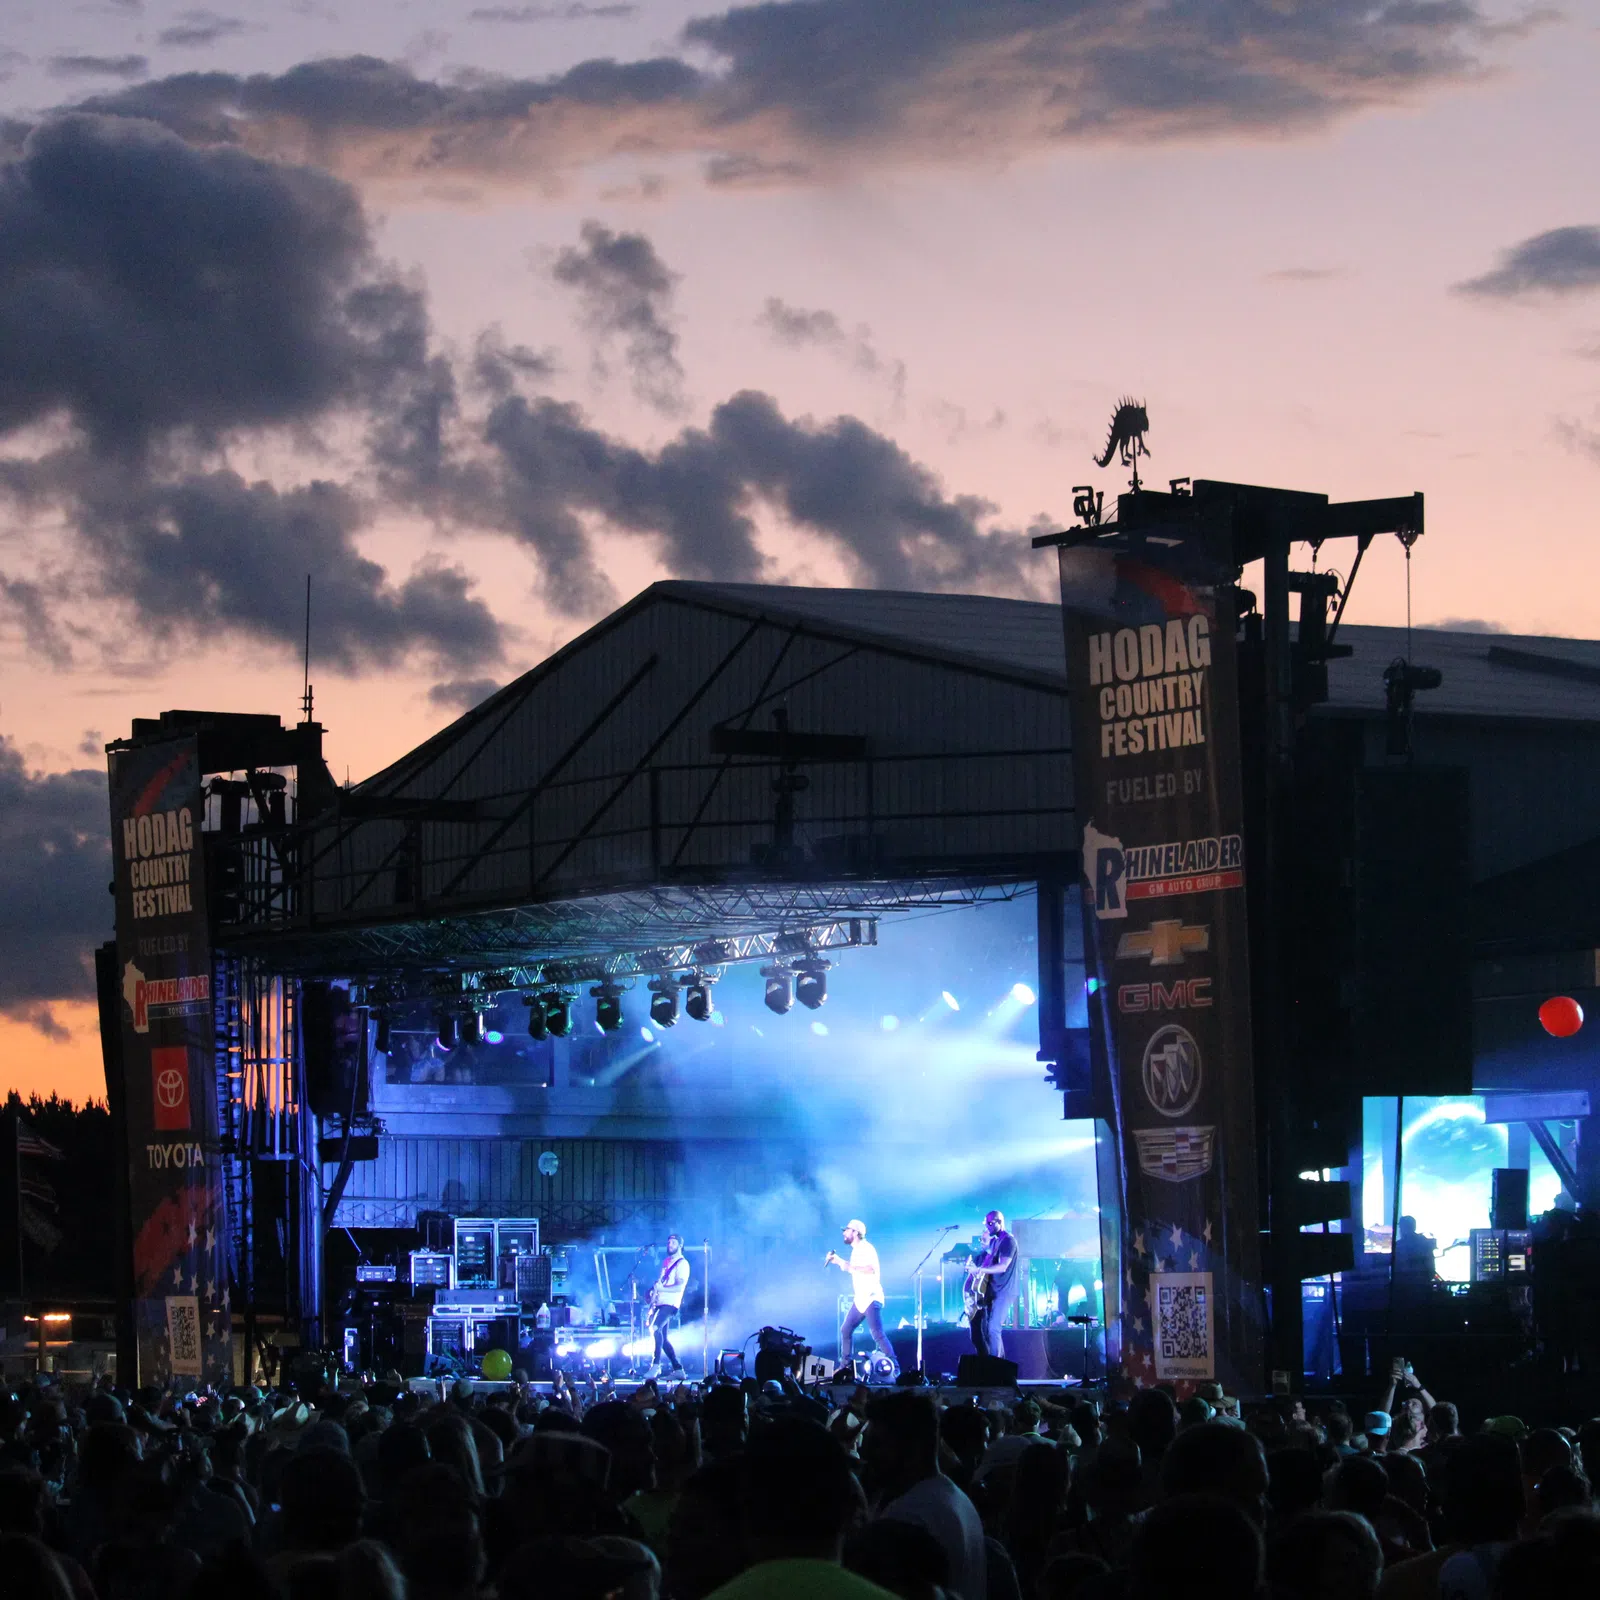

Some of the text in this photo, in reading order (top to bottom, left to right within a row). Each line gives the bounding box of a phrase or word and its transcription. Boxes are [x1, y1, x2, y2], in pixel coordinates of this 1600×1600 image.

[1089, 614, 1211, 686] HODAG
[1099, 671, 1204, 720] COUNTRY
[1101, 709, 1205, 758] FESTIVAL
[1106, 768, 1203, 805] FUELED BY
[123, 807, 194, 860] HODAG
[131, 854, 191, 889] COUNTRY
[1096, 834, 1242, 910] RHINELANDER
[1149, 883, 1164, 895] GM
[1168, 880, 1193, 893] AUTO
[133, 885, 193, 919] FESTIVAL
[139, 936, 176, 957] FUELED
[136, 975, 209, 1026] RHINELANDER
[1118, 977, 1213, 1013] GMC
[146, 1142, 205, 1169] TOYOTA
